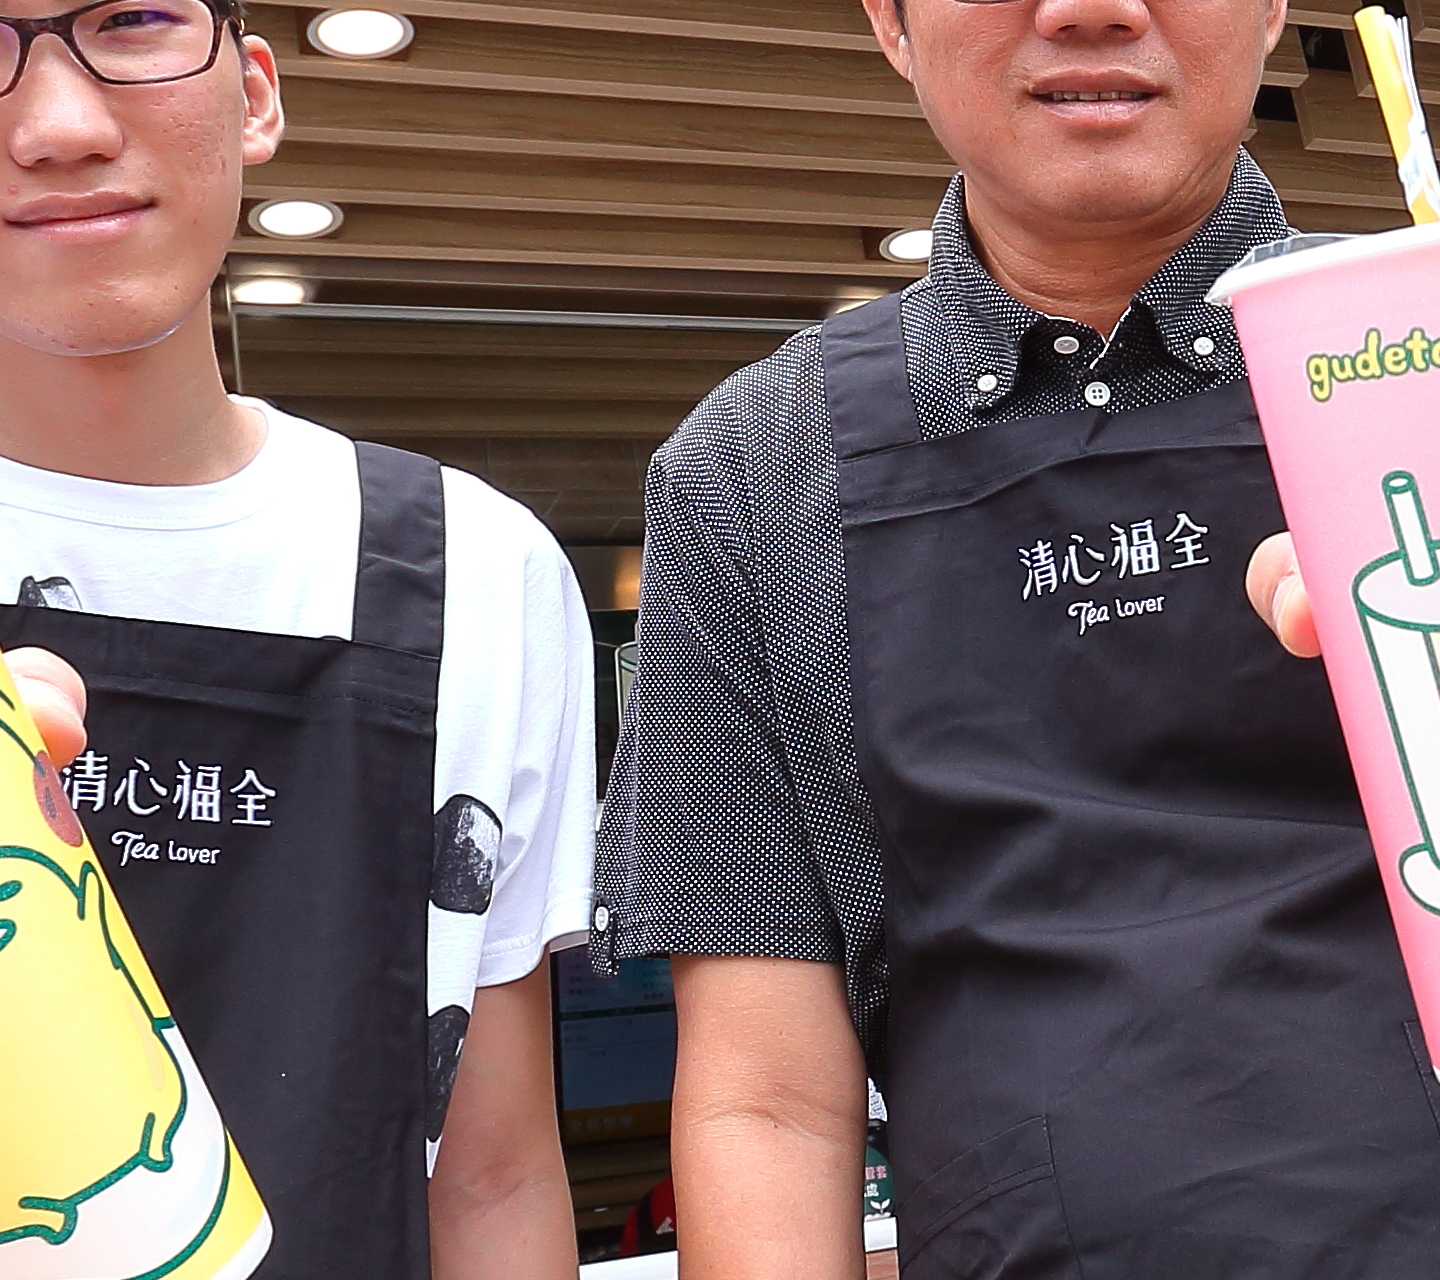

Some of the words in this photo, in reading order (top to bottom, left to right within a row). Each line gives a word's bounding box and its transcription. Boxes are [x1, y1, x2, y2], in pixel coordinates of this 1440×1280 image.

[1017, 513, 1210, 601] 清心福全
[1067, 599, 1110, 635] Tea
[62, 750, 277, 827] 清心福全
[111, 831, 160, 866] Tea
